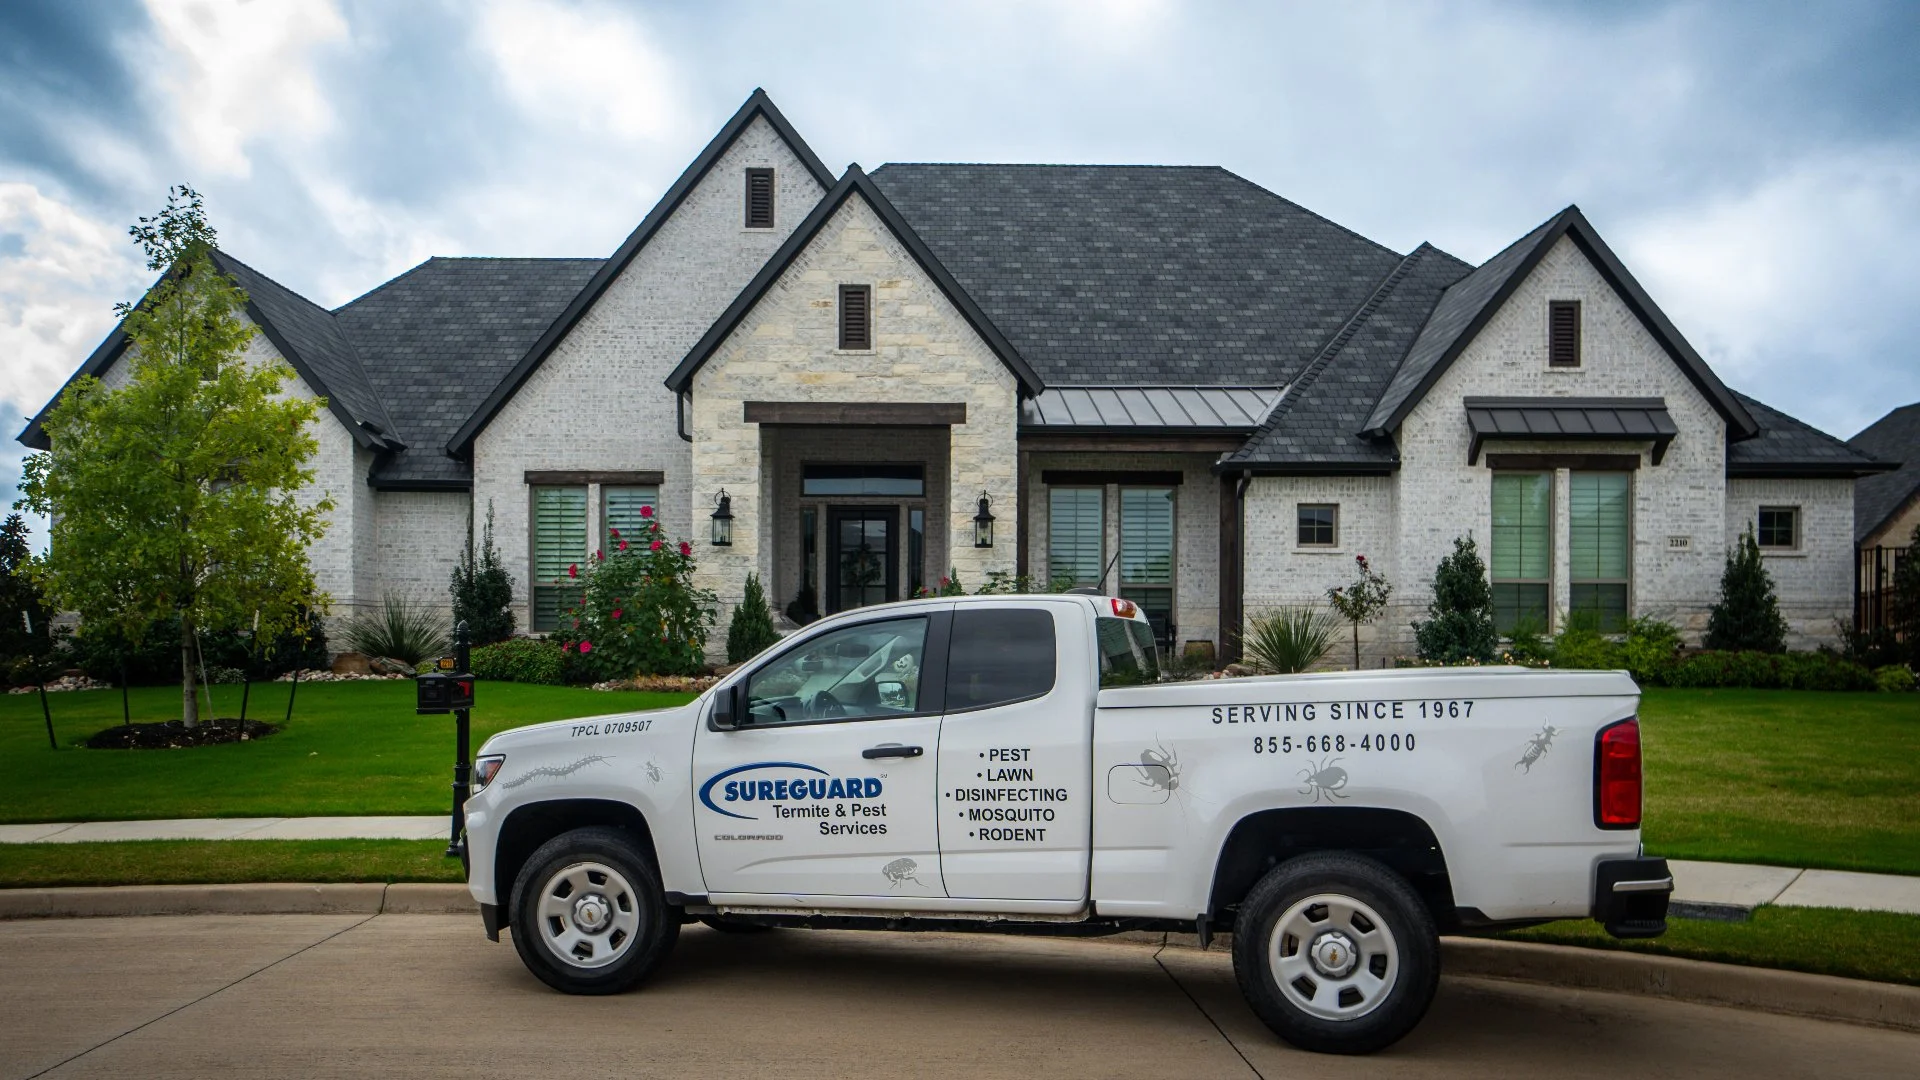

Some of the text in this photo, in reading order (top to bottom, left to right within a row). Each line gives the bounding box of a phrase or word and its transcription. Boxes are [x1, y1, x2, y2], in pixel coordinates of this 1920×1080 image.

[1669, 538, 1688, 547] 2210
[1211, 701, 1474, 724] SERVING SINCE 1967
[571, 720, 653, 738] TPCL 0709507
[1253, 733, 1416, 754] 855-668-4000
[989, 748, 1031, 762] PEST
[987, 768, 1034, 782] LAWN
[724, 777, 883, 802] SUREGUARD
[955, 788, 1068, 802] DISINFECTING
[772, 803, 887, 819] Termite & Pest
[968, 808, 1055, 822] MOSQUITO
[819, 820, 888, 836] Services
[979, 827, 1047, 842] RODENT
